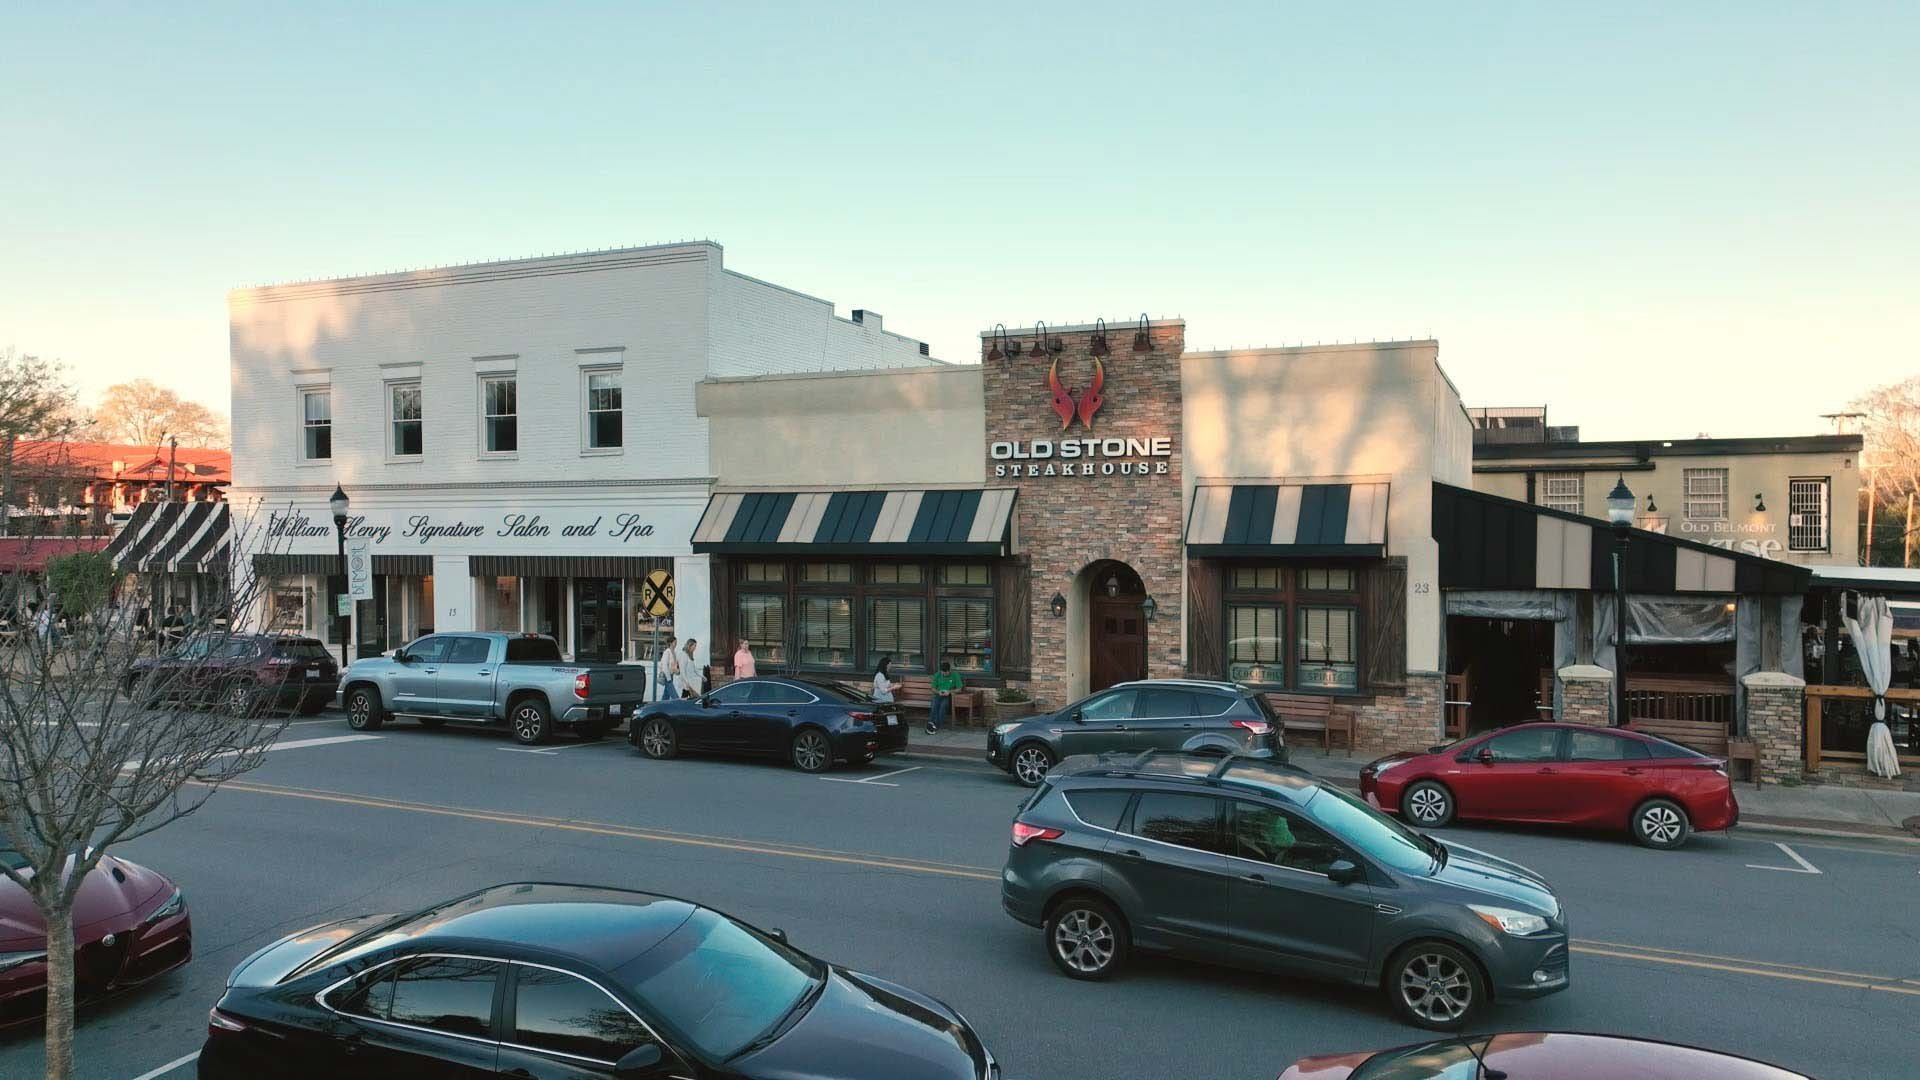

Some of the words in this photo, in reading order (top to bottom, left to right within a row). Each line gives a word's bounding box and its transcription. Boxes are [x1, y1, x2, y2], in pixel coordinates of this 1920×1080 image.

[990, 440, 1053, 460] OLD
[1060, 437, 1172, 458] STONE
[995, 461, 1168, 478] STEAKHOUSE
[271, 516, 330, 538] William
[343, 515, 391, 545] Henry
[402, 515, 485, 545] Signature
[496, 513, 551, 538] Salon
[561, 515, 603, 538] and
[608, 513, 655, 543] Spa
[1680, 521, 1709, 533] OLD
[1713, 521, 1777, 533] BELMONT
[1414, 582, 1430, 594] 23
